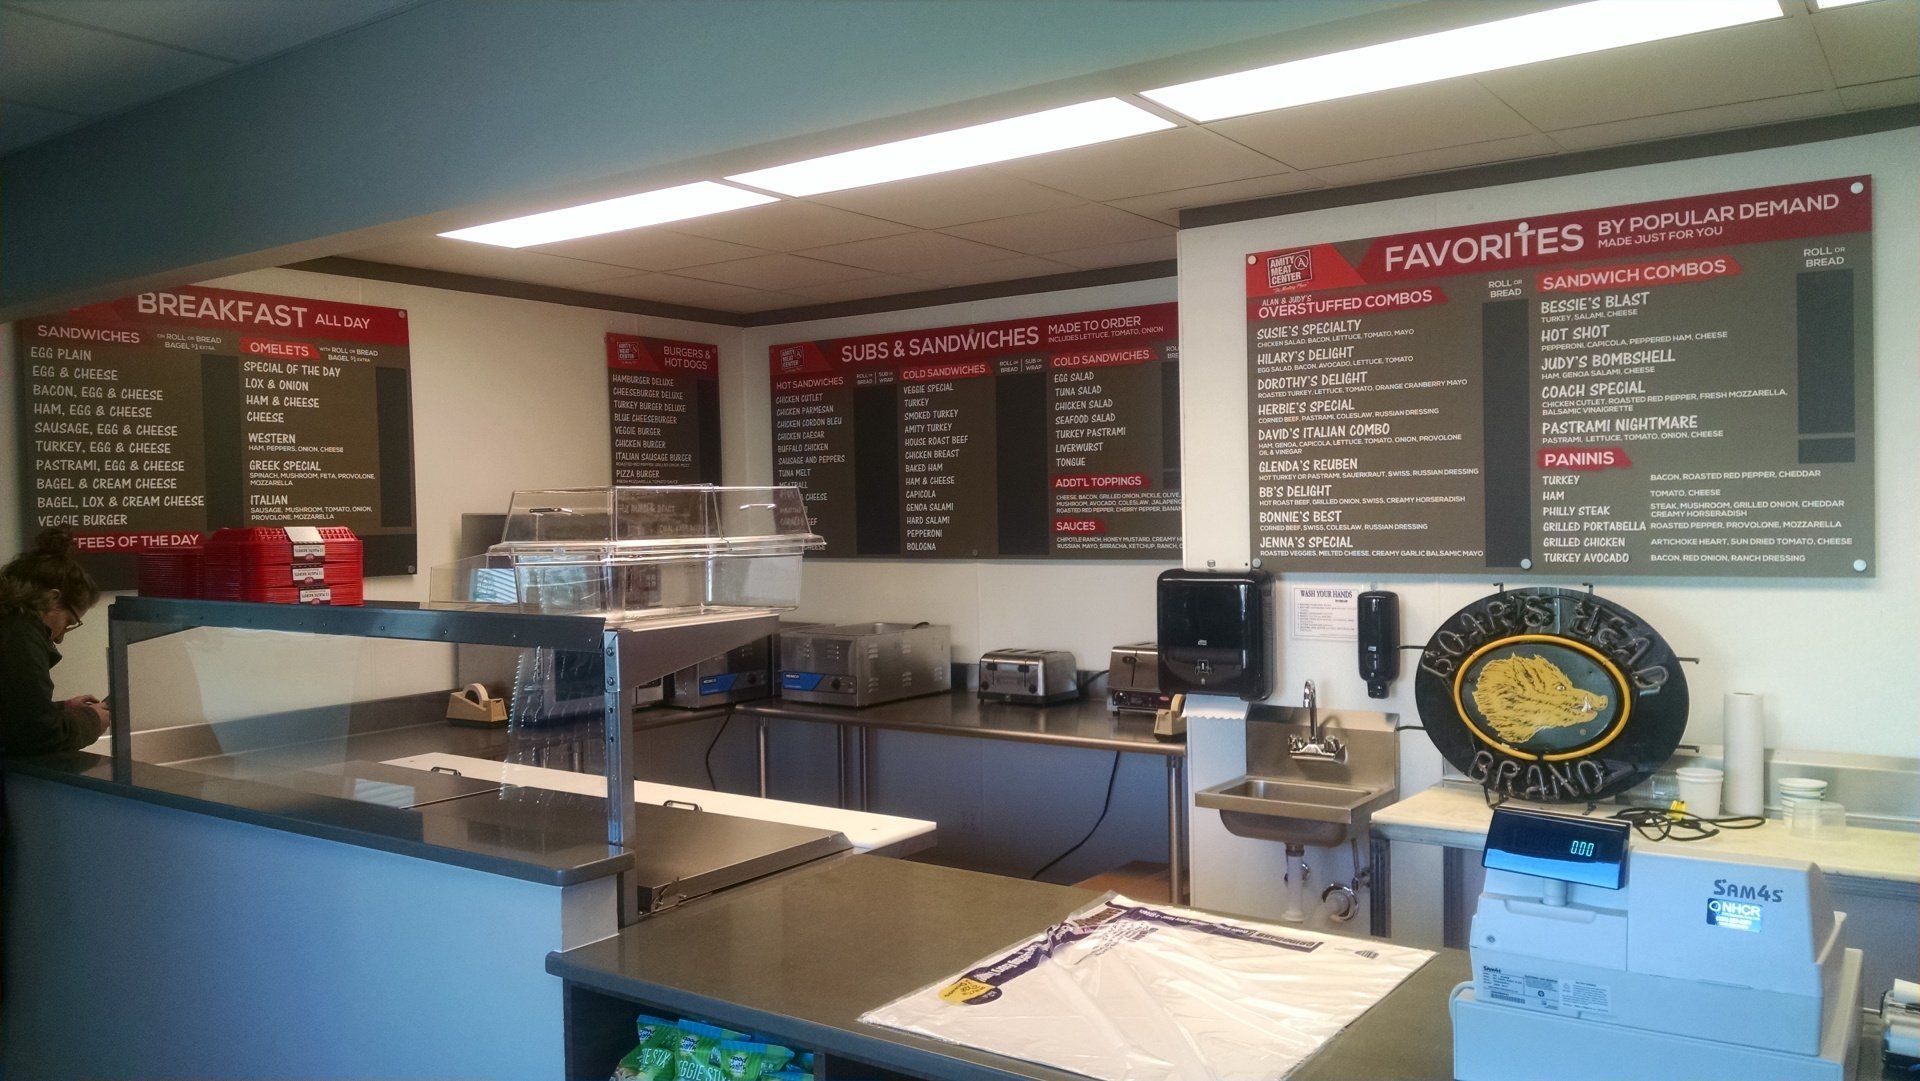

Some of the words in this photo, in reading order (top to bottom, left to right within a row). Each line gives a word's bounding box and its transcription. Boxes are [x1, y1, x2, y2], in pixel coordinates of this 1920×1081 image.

[1597, 219, 1623, 236] BY
[1629, 206, 1734, 233] POPULAR
[1739, 194, 1840, 220] DEMAND
[1597, 236, 1632, 249] MADE
[1634, 232, 1664, 245] JUST
[1668, 229, 1693, 241] FOR
[1696, 226, 1724, 238] YOU
[1385, 224, 1585, 272] FAVORITES
[1803, 247, 1831, 257] ROLL
[1270, 256, 1296, 268] AMITY
[1805, 256, 1845, 268] BREAD
[1270, 267, 1293, 275] MEAT
[1543, 268, 1639, 291] SANDWICH
[1643, 260, 1727, 281] COMBOS
[1271, 272, 1302, 285] CENTER
[1258, 297, 1362, 319] OVERSTUFFED
[1364, 290, 1433, 308] COMBOS
[1262, 298, 1279, 306] ALAN
[1288, 295, 1312, 304] JUDY'S
[1540, 297, 1600, 314] BESSIE'S
[1605, 292, 1650, 309] BLAST
[138, 292, 307, 328] BREAKFAST
[314, 314, 340, 327] ALL
[343, 317, 371, 329] DAY
[1048, 322, 1080, 334] MADE
[1084, 320, 1099, 331] TO
[1100, 316, 1141, 329] ORDER
[37, 325, 140, 344] SANDWICHES
[1257, 325, 1298, 340] SUSIE'S
[1302, 320, 1362, 336] SPECIALTY
[1541, 328, 1567, 342] HOT
[1572, 325, 1610, 340] SHOT
[250, 343, 309, 356] OMELETS
[841, 342, 888, 363] SUBS
[893, 340, 904, 358] &
[909, 326, 1040, 357] SANDWICHES
[31, 347, 53, 359] EGG
[57, 348, 92, 361] PLAIN
[663, 347, 703, 359] BURGERS
[704, 350, 711, 360] &
[1054, 356, 1080, 367] COLD
[1081, 350, 1150, 365] SANDWICHES
[1257, 350, 1305, 365] HILARY'S
[1308, 346, 1355, 361] DELIGHT
[1541, 355, 1587, 370] JUDY'S
[1592, 350, 1676, 367] BOMBSHELL
[243, 361, 283, 374] SPECIAL
[286, 364, 298, 375] OF
[301, 365, 319, 376] THE
[322, 366, 341, 377] DAY
[664, 359, 681, 368] HOT
[683, 360, 708, 370] DOGS
[32, 366, 55, 378] EGG
[59, 367, 68, 378] &
[73, 368, 119, 380] CHEESE
[903, 369, 925, 379] COLD
[927, 364, 986, 378] SANDWICHES
[1054, 373, 1068, 382] EGG
[1070, 372, 1095, 382] SALAD
[245, 378, 264, 389] LOX
[267, 379, 275, 390] &
[278, 380, 309, 391] ONION
[776, 381, 790, 389] HOT
[792, 377, 844, 388] SANDWICHES
[1257, 375, 1318, 390] DOROTHY'S
[1321, 372, 1368, 386] DELIGHT
[33, 385, 77, 398] BACON,
[81, 387, 103, 399] EGG
[107, 388, 116, 399] &
[120, 388, 163, 401] CHEESE
[1055, 387, 1075, 396] TUNA
[1077, 386, 1102, 395] SALAD
[1541, 384, 1585, 399] COACH
[1589, 381, 1646, 396] SPECIAL
[246, 395, 268, 406] HAM
[272, 396, 279, 406] &
[283, 397, 320, 408] CHEESE
[1258, 402, 1306, 415] HERBIE'S
[1309, 399, 1355, 413] SPECIAL
[1542, 408, 1581, 416] BALSAMIC
[1582, 405, 1634, 414] VINAIGRETTE
[246, 412, 285, 423] CHEESE
[1055, 415, 1089, 425] SEAFOOD
[1091, 413, 1116, 423] SALAD
[1542, 420, 1610, 434] PASTRAMI
[1615, 416, 1698, 431] NIGHTMARE
[248, 433, 296, 443] WESTERN
[1258, 427, 1299, 441] DAVID'S
[1303, 425, 1345, 439] ITALIAN
[1349, 423, 1391, 437] COMBO
[36, 441, 86, 453] TURKEY,
[89, 442, 111, 453] EGG
[115, 442, 124, 453] &
[128, 443, 171, 454] CHEESE
[1055, 442, 1104, 453] LIVERWURST
[249, 460, 280, 470] GREEK
[283, 461, 322, 471] SPECIAL
[1056, 458, 1086, 467] TONGUE
[1259, 460, 1310, 472] GLENDA'S
[1313, 458, 1358, 471] REUBEN
[1545, 451, 1615, 467] PANINIS
[636, 470, 660, 478] BURGER
[905, 464, 926, 472] BAKED
[927, 464, 943, 472] HAM
[37, 479, 74, 489] BAGEL
[78, 479, 87, 489] &
[91, 478, 131, 489] CREAM
[135, 478, 177, 489] CHEESE
[1055, 478, 1088, 487] ADDT'L
[1092, 477, 1142, 486] TOPPINGS
[1542, 476, 1580, 485] TURKEY
[906, 490, 936, 498] CAPICOLA
[1259, 486, 1283, 497] BB'S
[1286, 485, 1332, 497] DELIGHT
[1542, 491, 1565, 501] HAM
[250, 495, 288, 505] ITALIAN
[1259, 511, 1309, 523] BONNIE'S
[1313, 511, 1342, 522] BEST
[1542, 506, 1575, 516] PHILLY
[1578, 506, 1610, 516] STEAK
[1056, 522, 1096, 531] SAUCES
[1542, 522, 1580, 532] GRILLED
[1583, 521, 1647, 531] PORTABELLA
[118, 536, 137, 548] OF
[142, 535, 168, 547] THE
[171, 535, 200, 546] DAY
[1259, 537, 1305, 548] JENNA'S
[1308, 537, 1354, 548] SPECIAL
[1543, 537, 1580, 547] GRILLED
[1583, 537, 1626, 547] CHICKEN
[1543, 553, 1580, 563] TURKEY
[1583, 553, 1630, 563] AVOCADO
[1300, 590, 1315, 598] WASH
[1316, 590, 1331, 598] YOUR
[1332, 590, 1353, 598] HANDS
[1469, 749, 1603, 800] BRAND
[1721, 901, 1761, 917] NHCR
